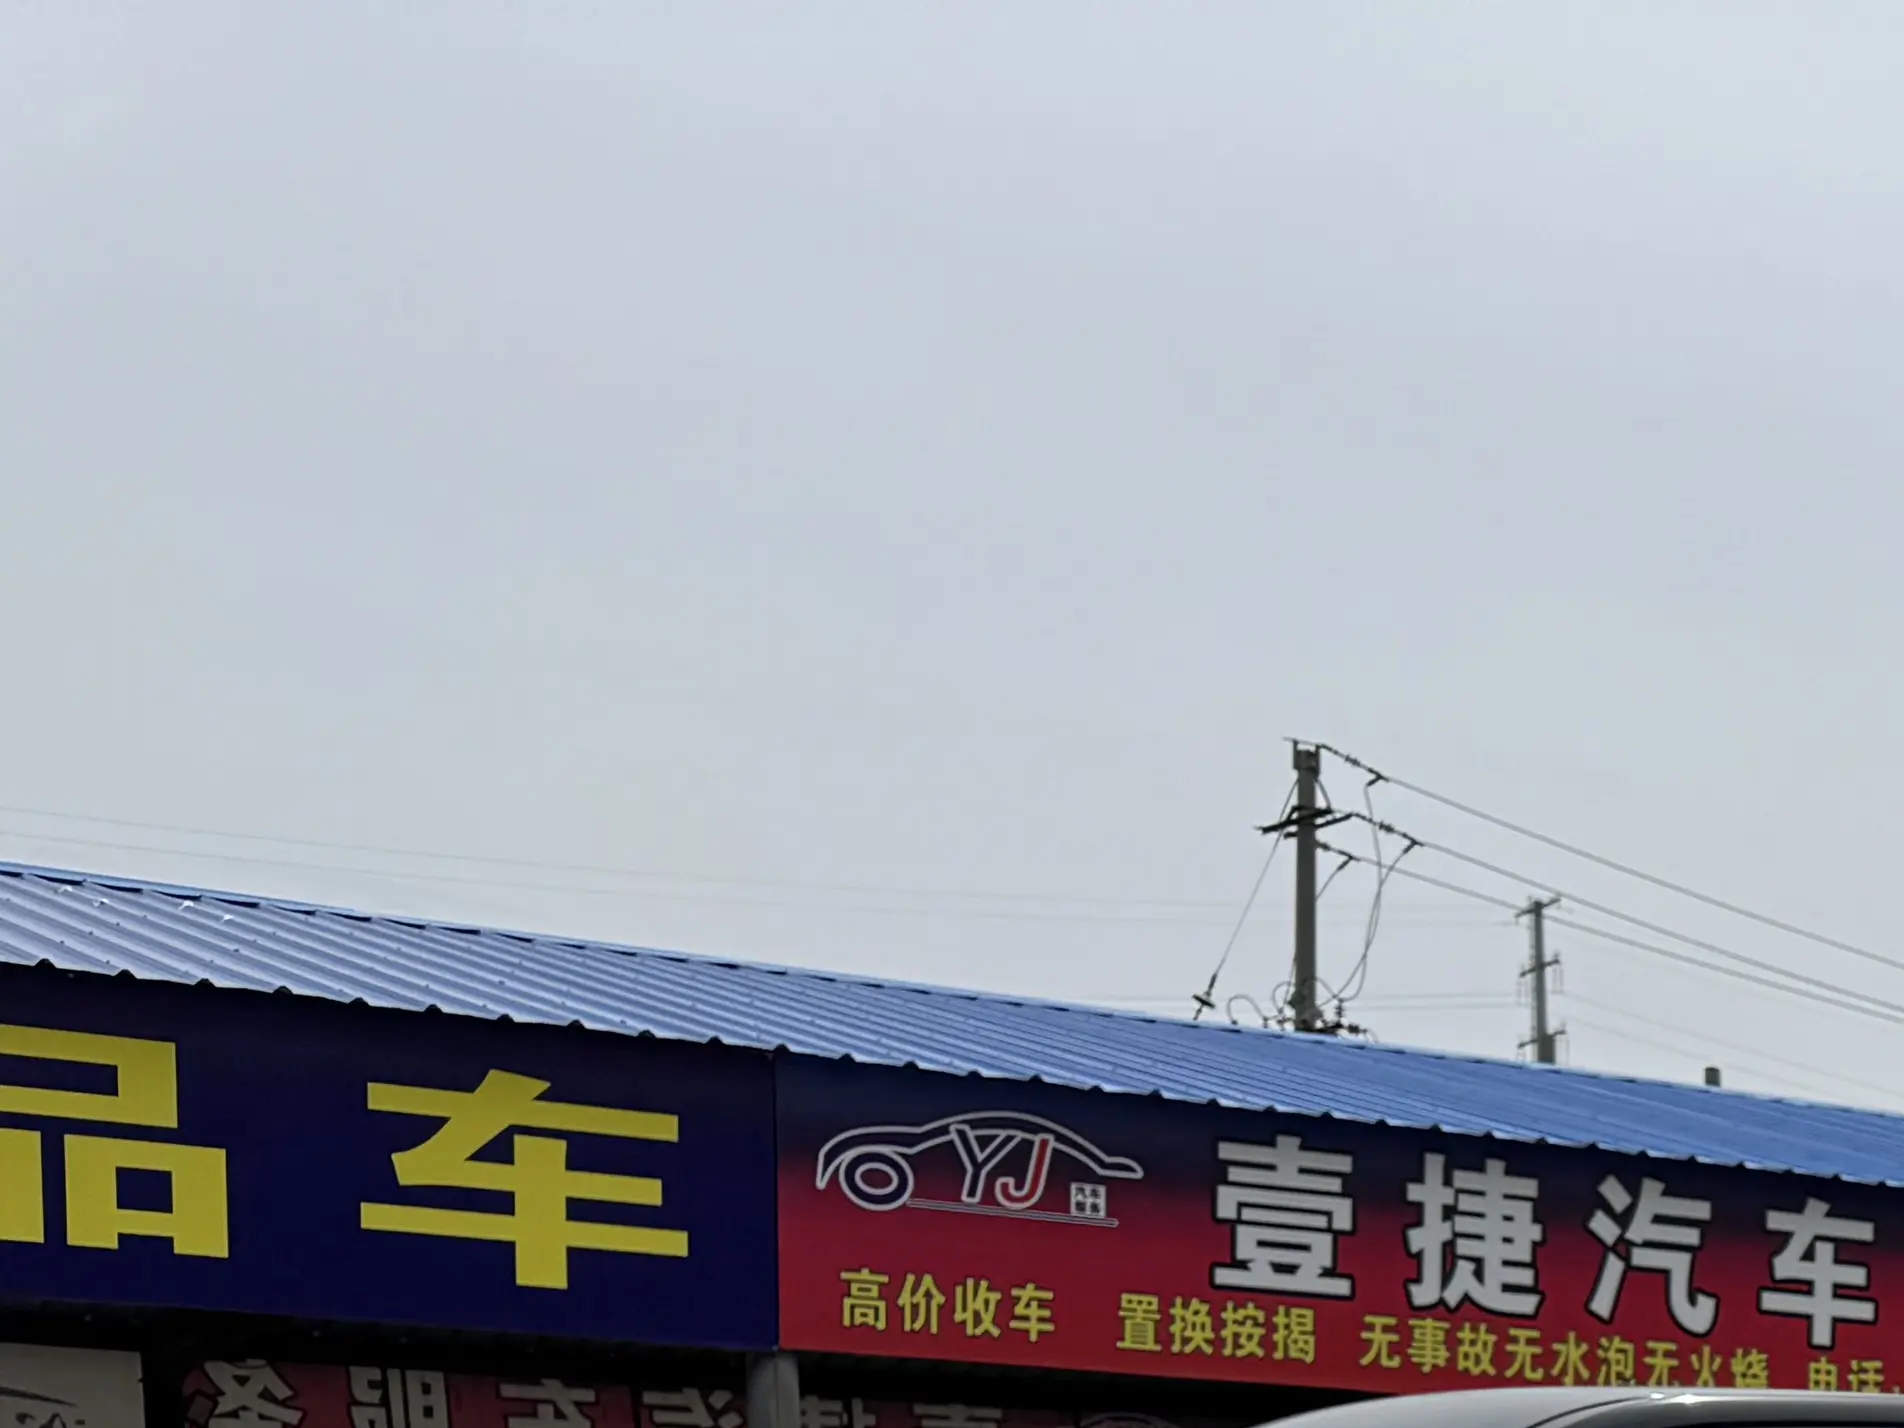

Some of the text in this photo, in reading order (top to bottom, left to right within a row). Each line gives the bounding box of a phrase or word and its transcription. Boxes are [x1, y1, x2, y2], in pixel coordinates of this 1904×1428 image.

[0, 1022, 690, 1291] 品车
[839, 1268, 1057, 1342] 高价收车
[1116, 1292, 1316, 1364] 置换按揭
[1359, 1315, 1770, 1388] 无事故无水泡无火烧
